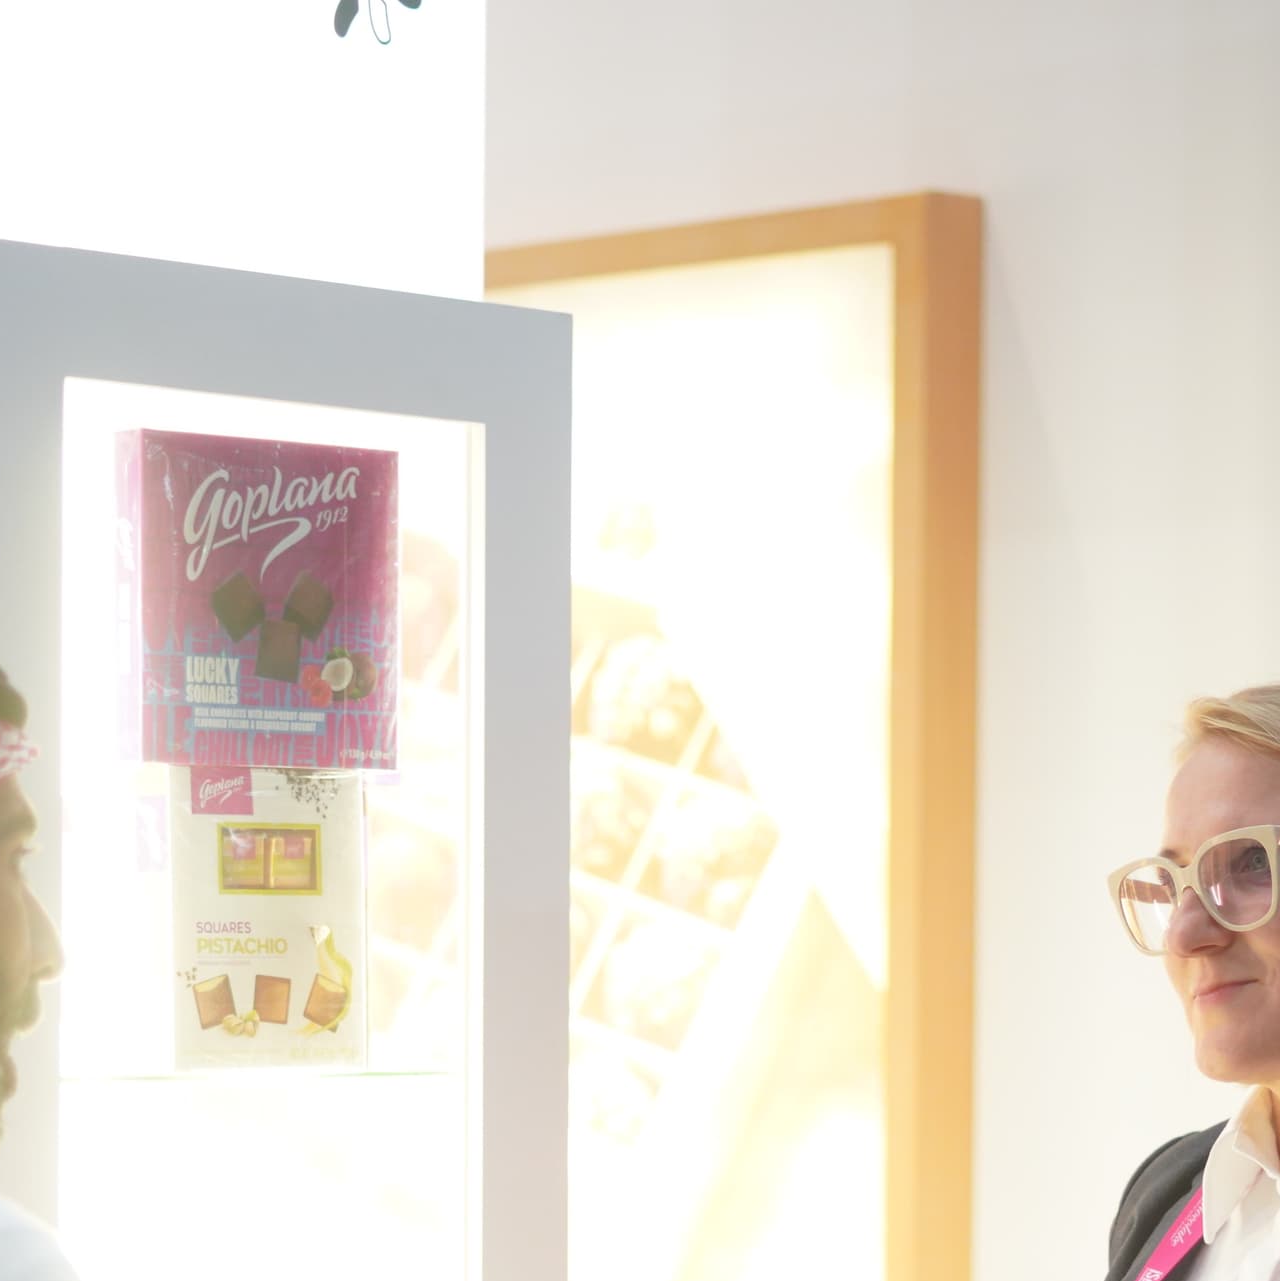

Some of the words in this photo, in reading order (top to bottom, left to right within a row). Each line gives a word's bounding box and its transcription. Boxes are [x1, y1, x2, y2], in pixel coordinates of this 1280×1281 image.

[183, 465, 361, 582] Goplana
[315, 506, 349, 532] 1912
[185, 655, 240, 684] LUCKY
[185, 684, 238, 704] SQUARES
[196, 921, 252, 934] SQUARES
[196, 938, 288, 955] PISTACHIO
